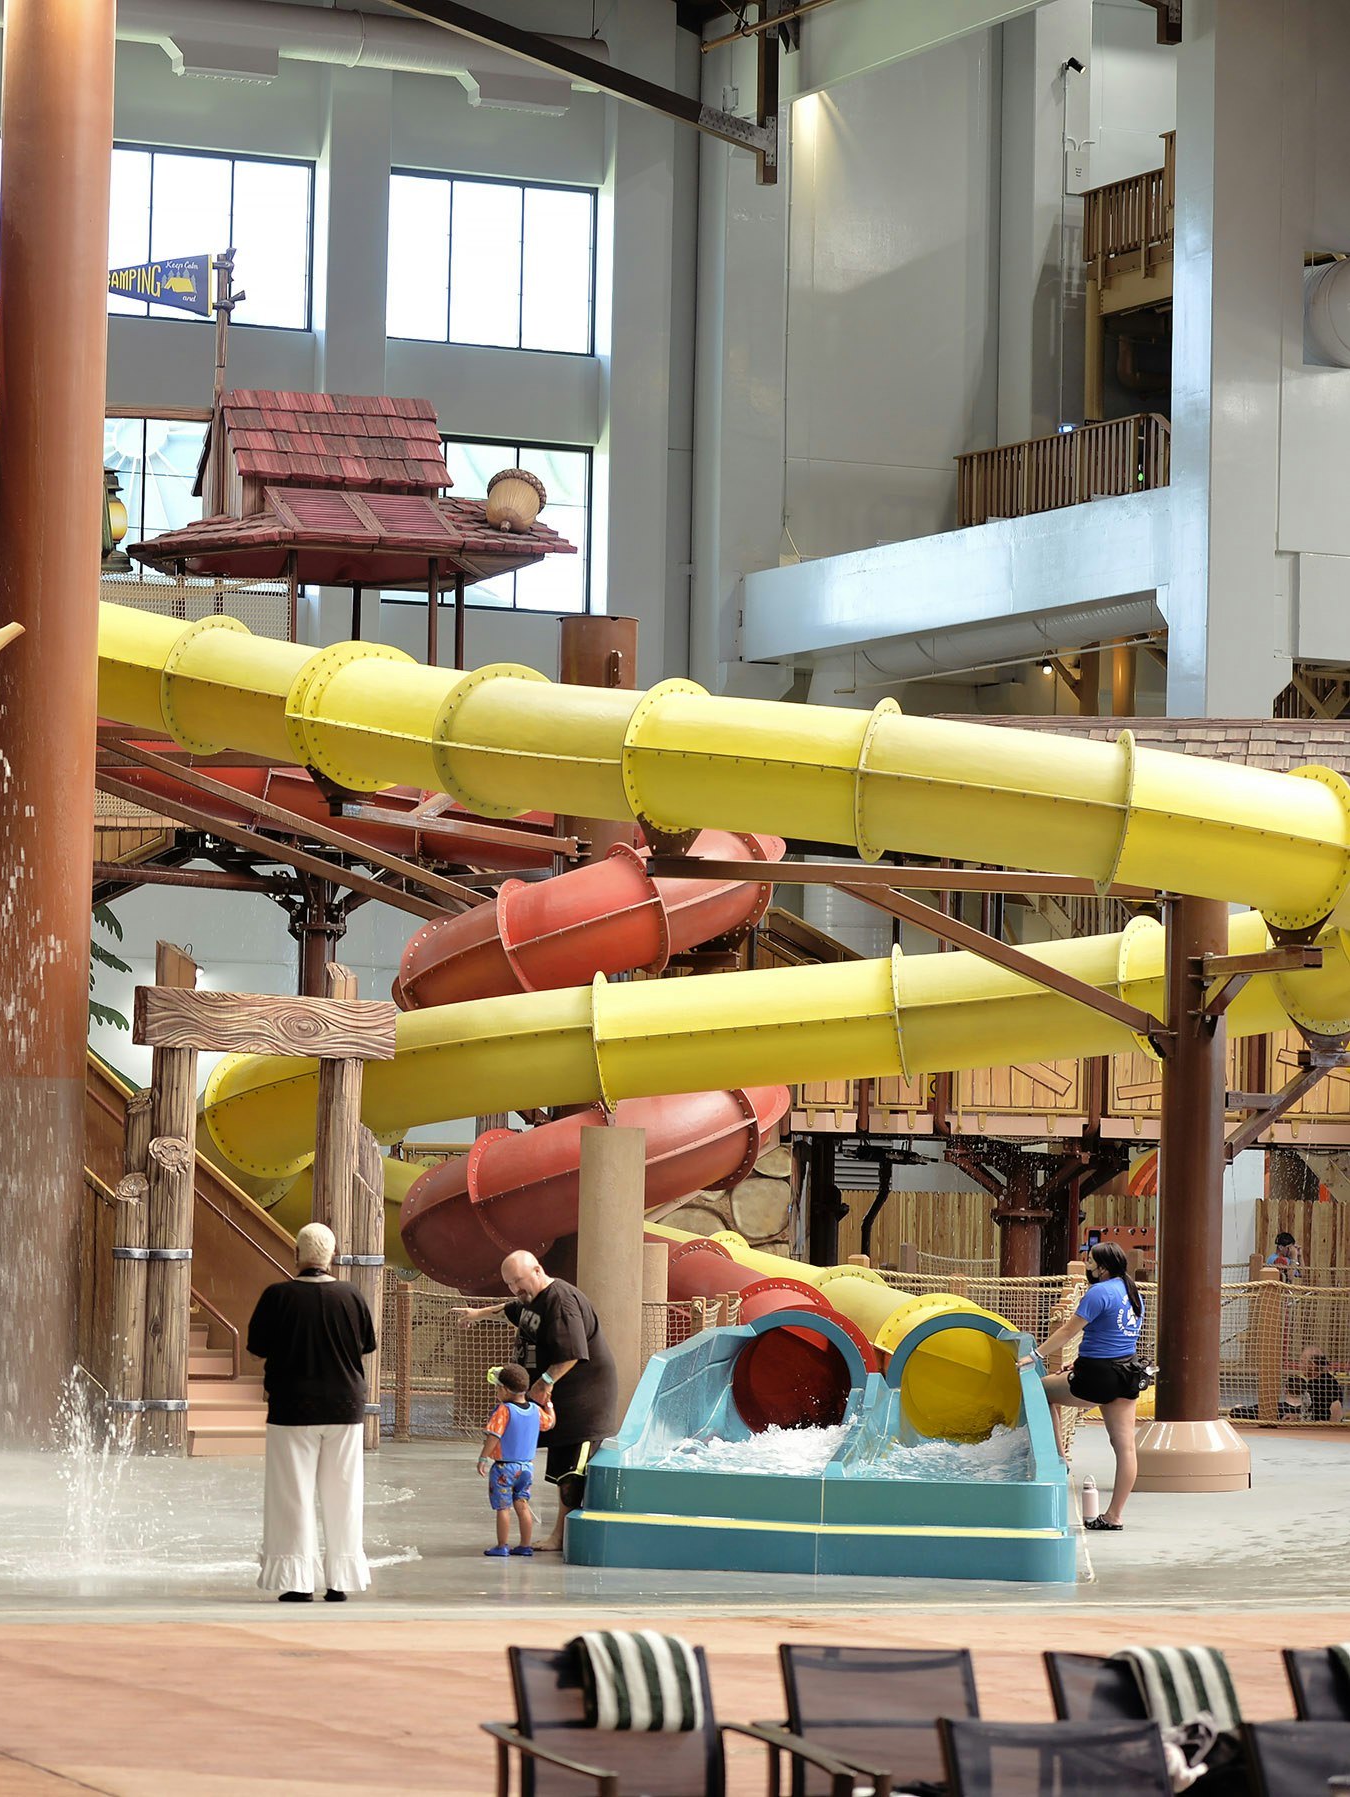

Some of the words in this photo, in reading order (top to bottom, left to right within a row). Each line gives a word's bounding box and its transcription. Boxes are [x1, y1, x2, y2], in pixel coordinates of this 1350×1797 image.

[165, 260, 183, 271] Keep
[184, 260, 199, 270] Calm
[108, 264, 162, 298] AMPING
